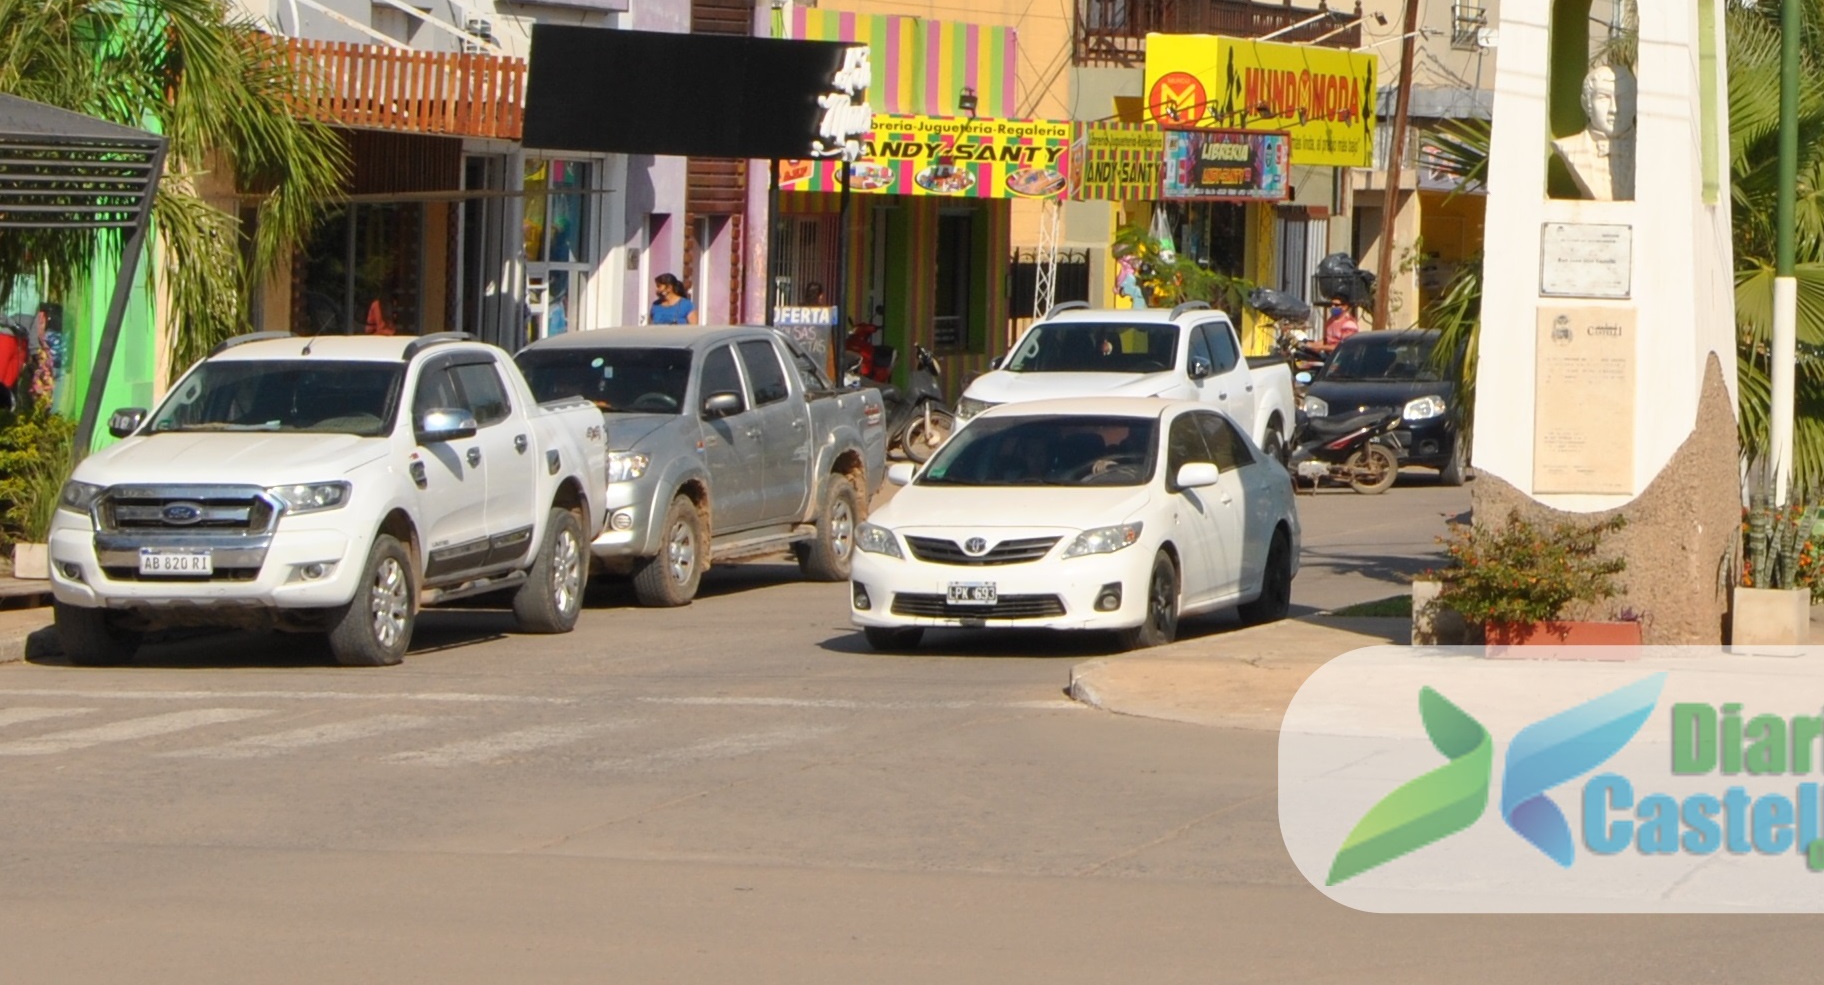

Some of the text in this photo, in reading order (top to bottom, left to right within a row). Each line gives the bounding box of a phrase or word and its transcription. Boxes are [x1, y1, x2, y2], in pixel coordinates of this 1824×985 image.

[144, 557, 160, 570] AB
[164, 557, 188, 570] 820
[974, 587, 995, 600] 693
